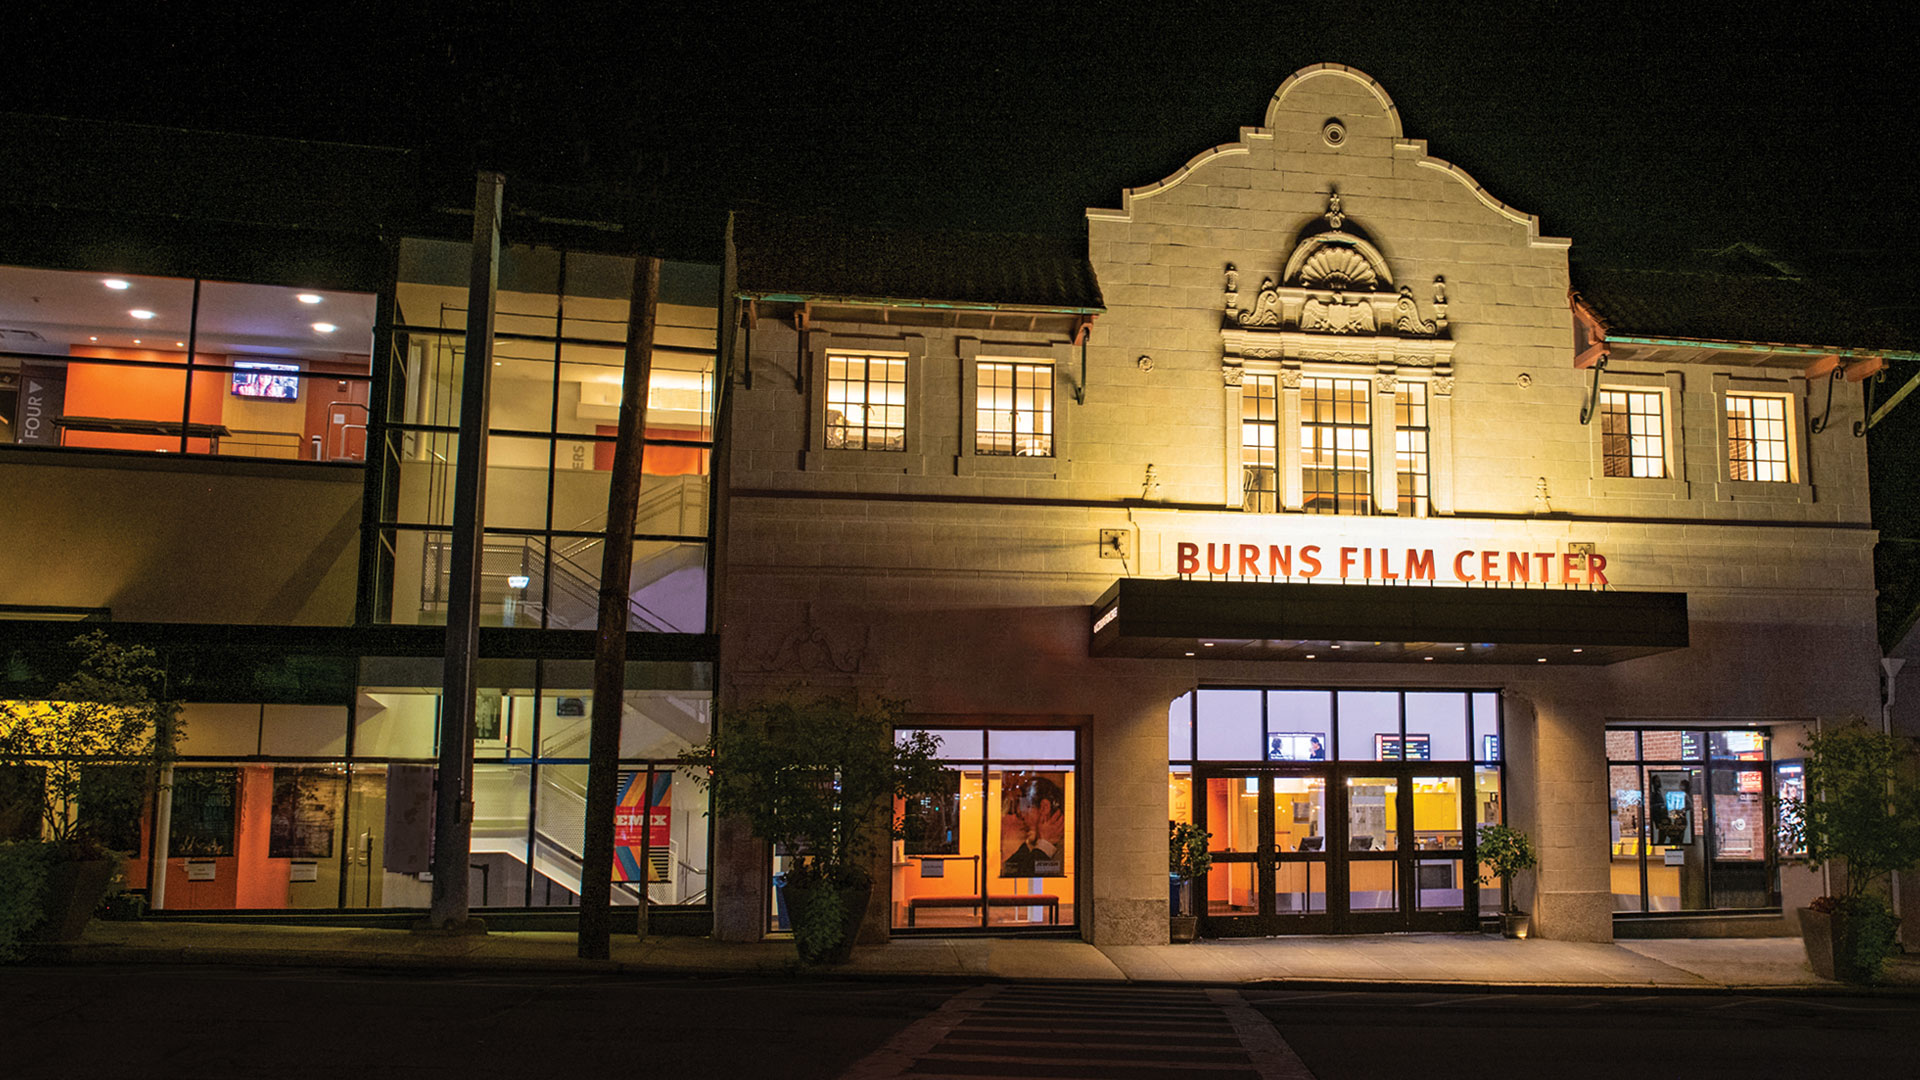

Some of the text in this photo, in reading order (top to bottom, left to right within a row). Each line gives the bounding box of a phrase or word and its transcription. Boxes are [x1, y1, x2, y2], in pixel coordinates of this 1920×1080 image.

[24, 396, 43, 439] FOUR
[572, 445, 584, 471] ERS
[1177, 542, 1609, 587] BURNS FILM CENTER
[616, 814, 667, 826] EMIX
[1175, 801, 1186, 821] NE
